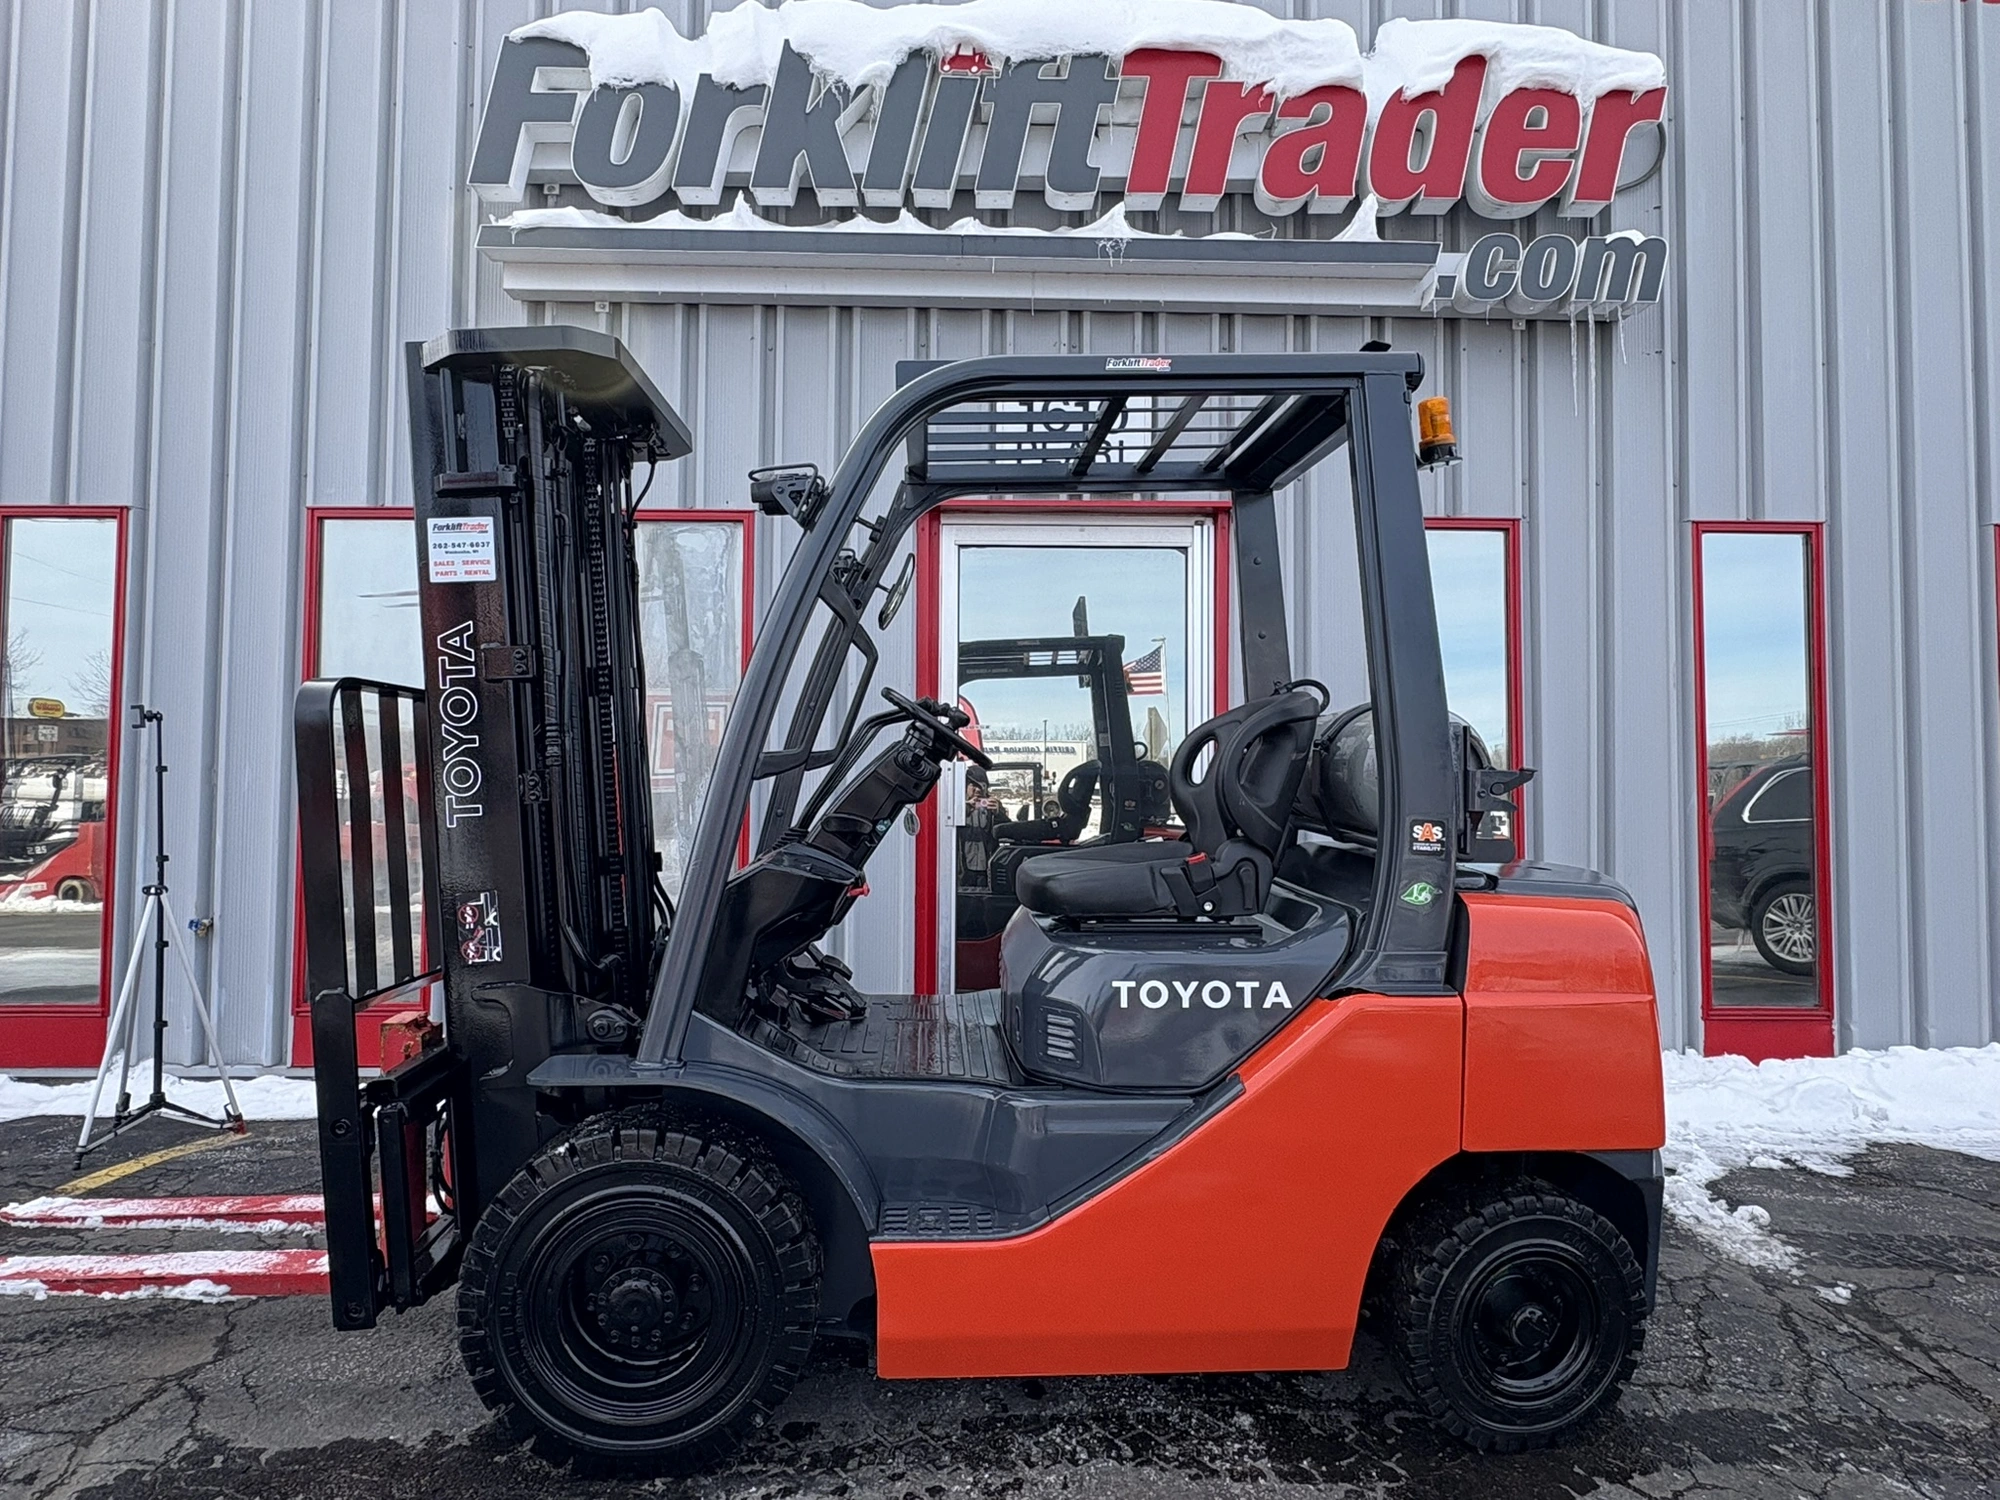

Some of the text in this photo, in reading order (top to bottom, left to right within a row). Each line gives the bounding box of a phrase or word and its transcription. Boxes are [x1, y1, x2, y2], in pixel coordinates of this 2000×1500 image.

[468, 35, 1669, 204] ForkliftTrader
[1437, 233, 1669, 304] .com
[1106, 358, 1171, 367] ForkliftTrader
[432, 523, 489, 531] ForkliftTrader
[437, 620, 483, 828] TOYOTA
[1412, 822, 1443, 842] SAS
[1111, 979, 1292, 1009] TOYOTA
